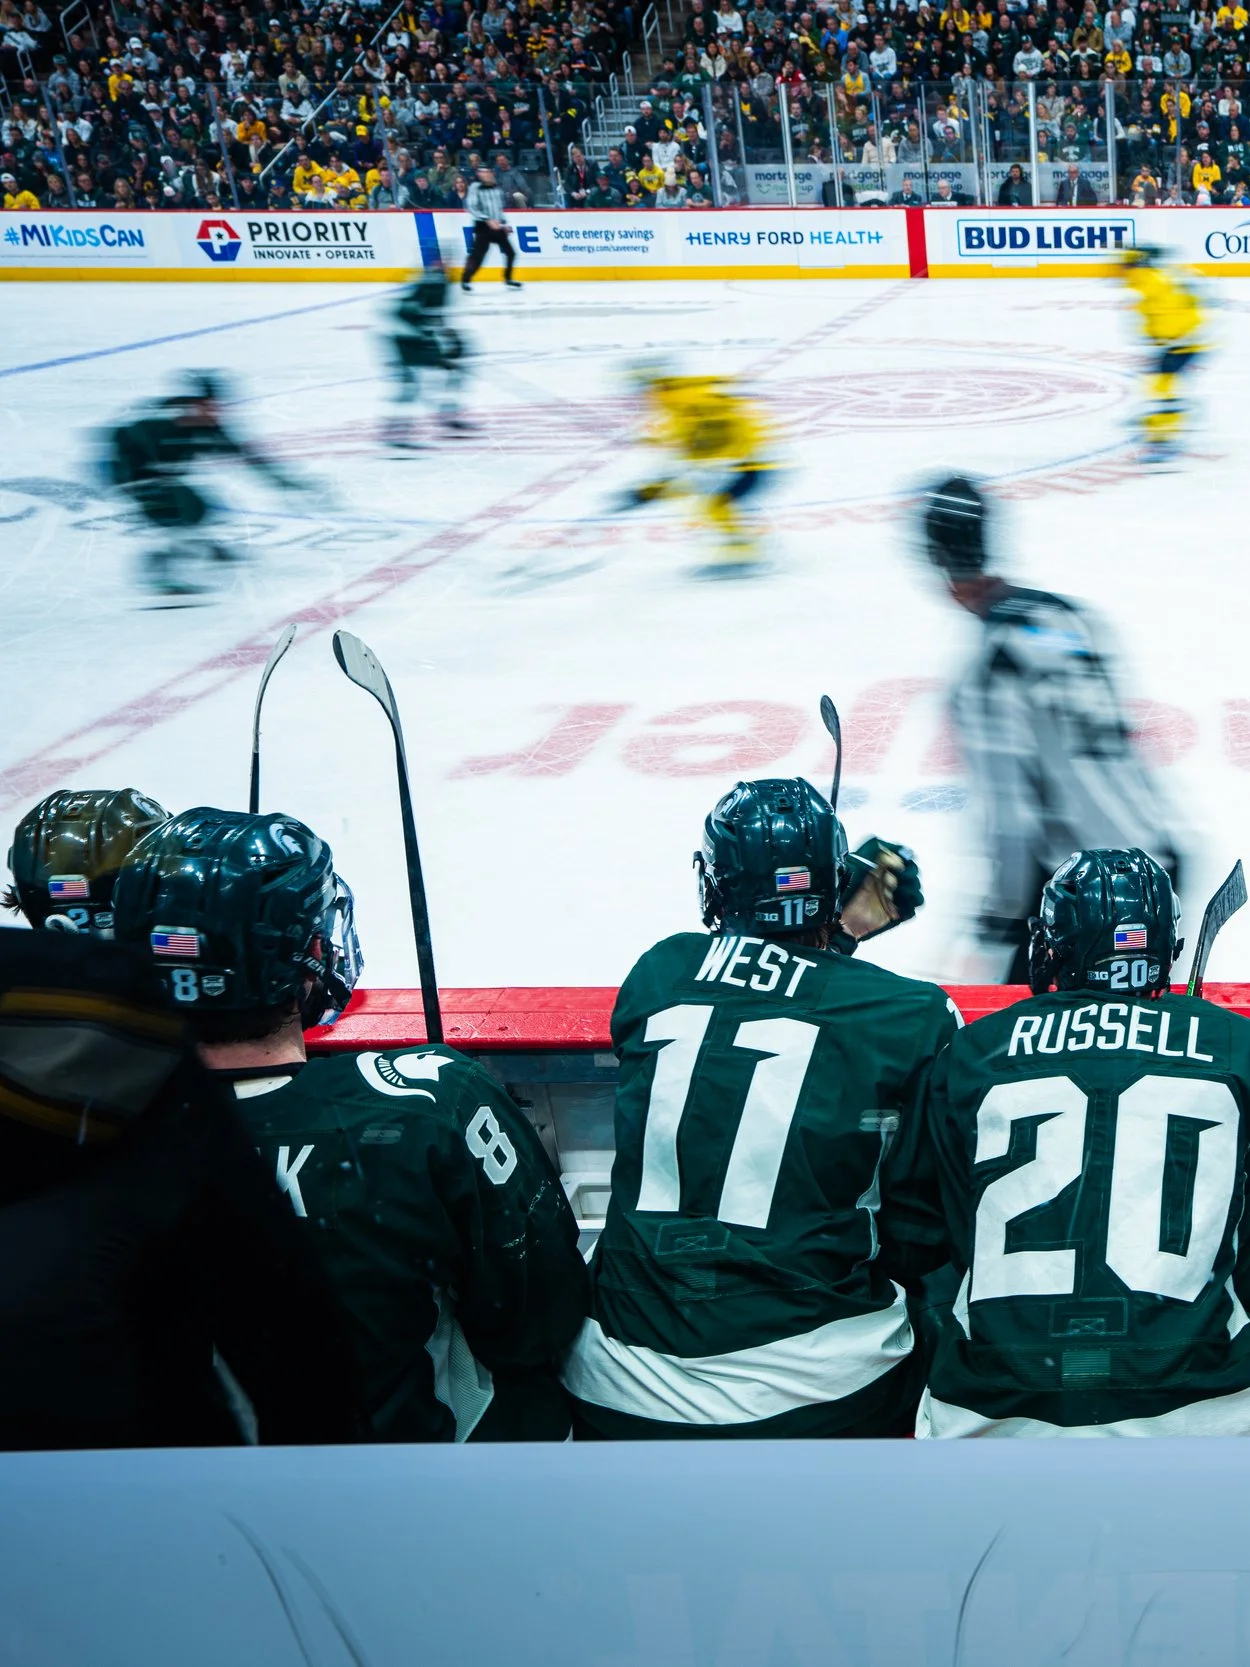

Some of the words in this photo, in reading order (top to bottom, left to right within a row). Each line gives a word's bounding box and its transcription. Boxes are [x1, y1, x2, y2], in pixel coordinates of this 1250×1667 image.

[248, 221, 368, 243] PRIORITY
[552, 227, 580, 239] Score
[582, 229, 615, 241] energy
[617, 227, 655, 241] savings
[685, 231, 751, 245] HENRY
[757, 231, 804, 245] FORD
[810, 230, 884, 244] HEALTH
[964, 226, 1030, 250] BUD
[1036, 226, 1128, 249] LIGHT
[253, 250, 311, 260] INNOVATE
[325, 250, 376, 260] OPERATE
[780, 898, 804, 926] 11
[694, 936, 817, 998] WEST
[1110, 959, 1148, 989] 20
[171, 968, 199, 1002] 8
[1007, 1002, 1214, 1063] RUSSELL
[635, 1003, 821, 1230] 11
[465, 1104, 518, 1185] 8
[275, 1143, 315, 1218] K
[970, 1074, 1240, 1302] 20
